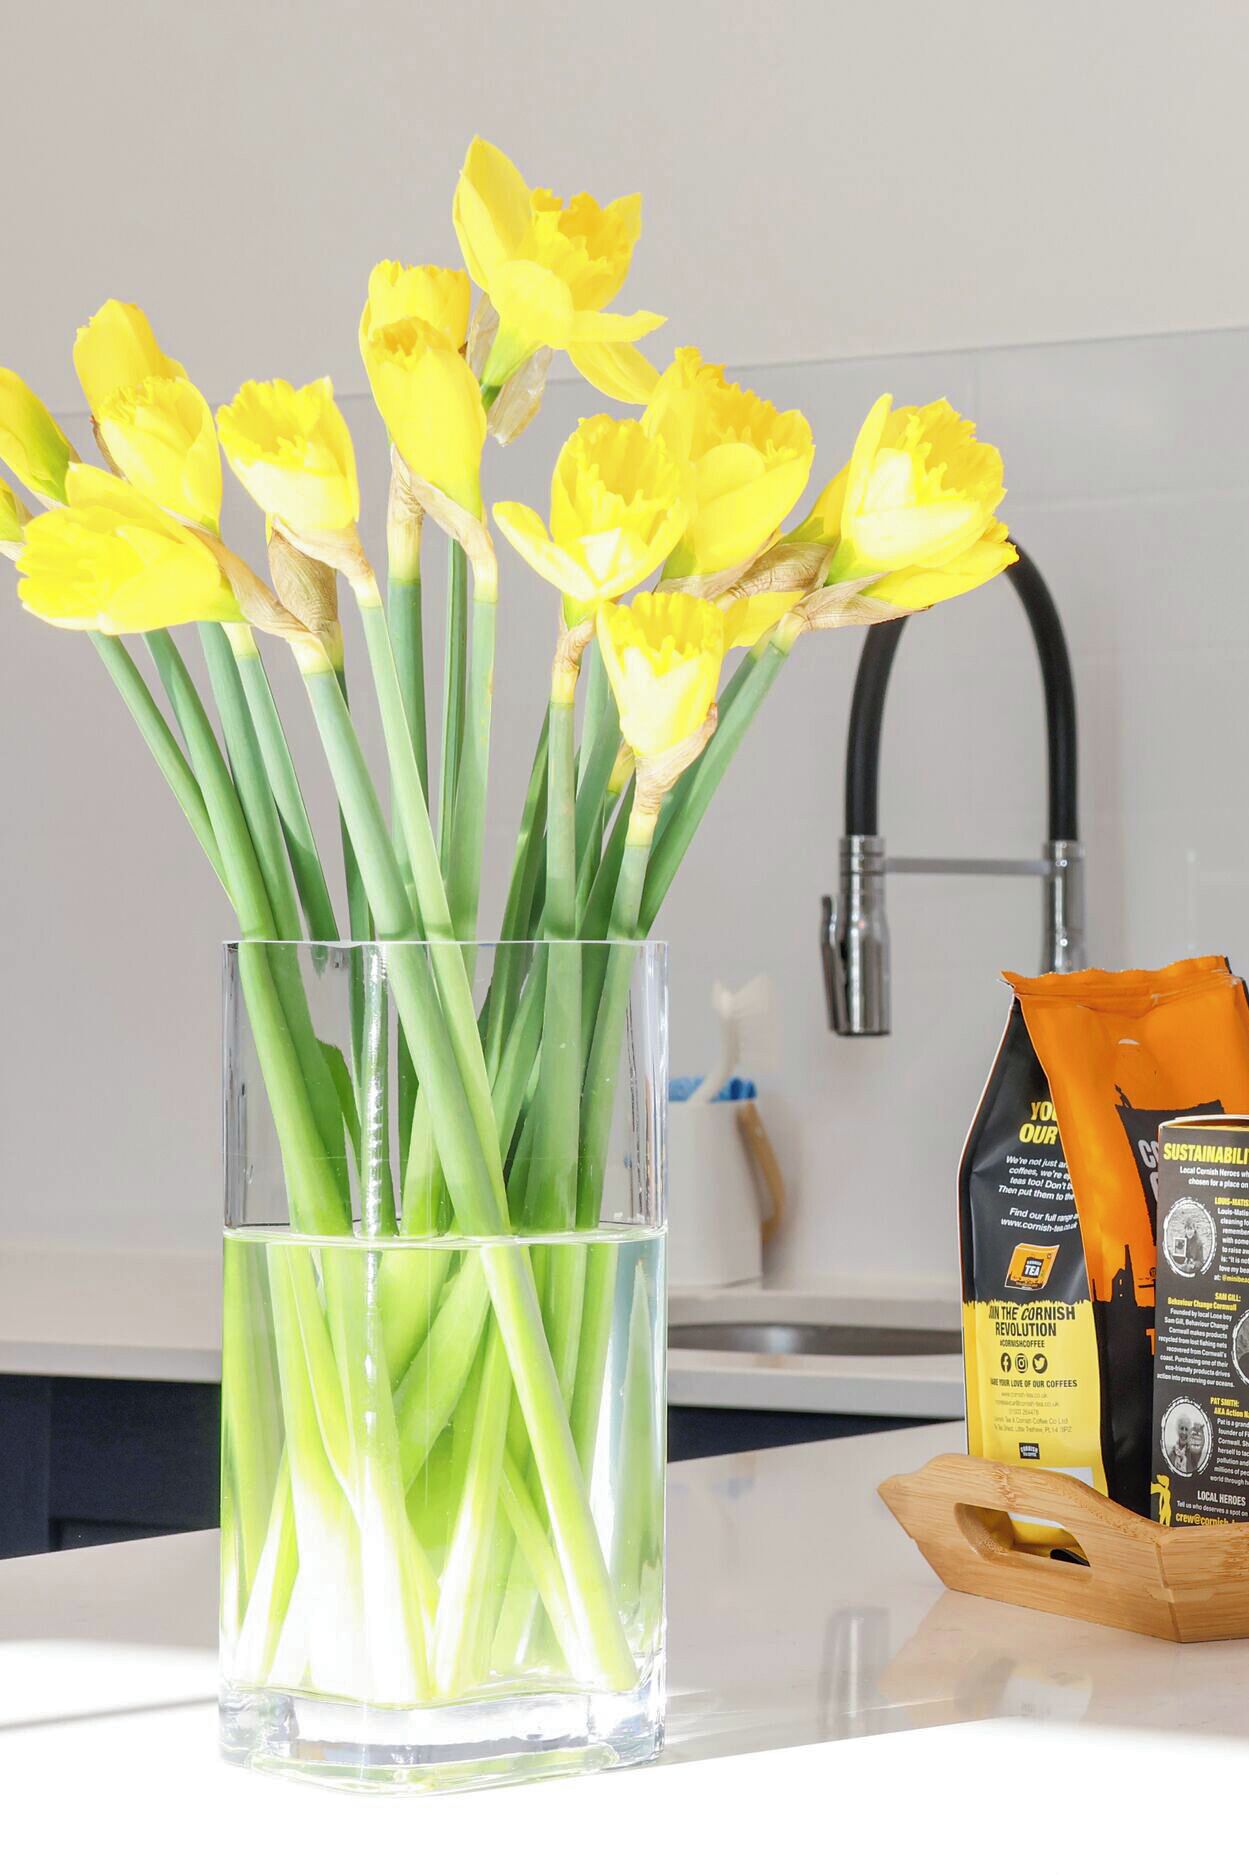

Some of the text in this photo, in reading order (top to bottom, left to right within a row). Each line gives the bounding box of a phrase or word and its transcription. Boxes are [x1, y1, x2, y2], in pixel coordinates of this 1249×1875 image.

[1019, 1123, 1058, 1144] OUR
[1006, 1155, 1028, 1164] We're
[1042, 1160, 1057, 1168] just
[1009, 1167, 1062, 1179] coffees, we're
[1180, 1166, 1195, 1174] Local
[1196, 1167, 1218, 1177] Cornish
[1219, 1168, 1240, 1178] Heroes
[1010, 1177, 1066, 1190] teas too! Don't
[1188, 1178, 1210, 1186] chosen
[1224, 1181, 1239, 1190] place
[998, 1185, 1018, 1194] Then
[1034, 1190, 1054, 1200] them
[1010, 1207, 1028, 1218] Find
[1029, 1212, 1043, 1220] our
[1220, 1218, 1243, 1227] cleaning
[1024, 1265, 1040, 1276] TEA
[1194, 1300, 1212, 1309] Change
[1001, 1306, 1075, 1320] THE CORNISH
[1170, 1308, 1191, 1316] Founded
[995, 1322, 1056, 1336] REVOLUTION
[1186, 1319, 1209, 1327] Behaviour
[1210, 1322, 1228, 1330] Change
[1206, 1331, 1227, 1339] products
[1200, 1340, 1215, 1348] fishing
[1166, 1346, 1190, 1354] recovered
[1175, 1356, 1201, 1366] Purchasing
[1165, 1364, 1215, 1376] eco-friendly products
[1011, 1379, 1022, 1387] LOVE
[1181, 1376, 1206, 1385] preserving
[1226, 1409, 1243, 1417] Action
[1218, 1428, 1237, 1436] founder
[1218, 1447, 1235, 1455] herself
[1217, 1457, 1238, 1465] pollution
[1225, 1477, 1244, 1486] through
[1197, 1490, 1246, 1506] LOCAL HEROES
[1203, 1505, 1224, 1514] deserves
[1230, 1509, 1241, 1517] spot
